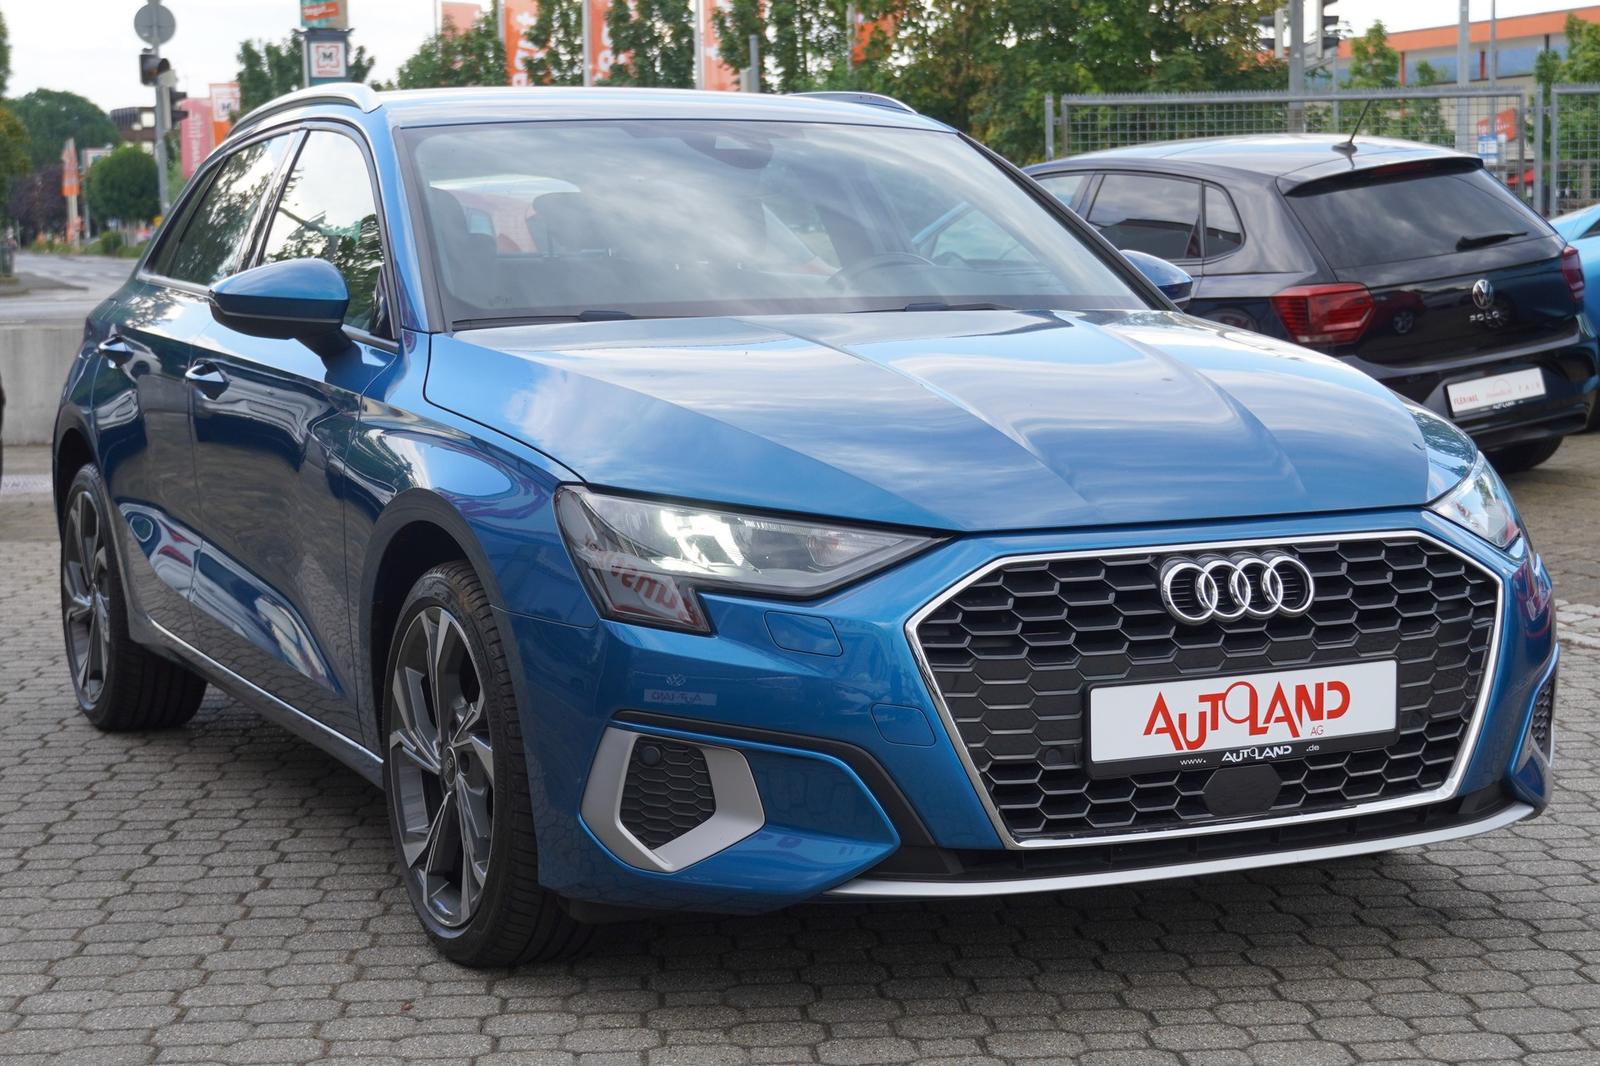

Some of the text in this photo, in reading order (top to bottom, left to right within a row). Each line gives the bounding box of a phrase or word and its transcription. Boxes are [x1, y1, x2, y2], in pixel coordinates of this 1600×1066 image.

[1470, 311, 1500, 321] POLO
[1143, 681, 1350, 750] AUTOLAND
[1310, 725, 1324, 736] AG
[1222, 745, 1293, 763] AUTOLAND
